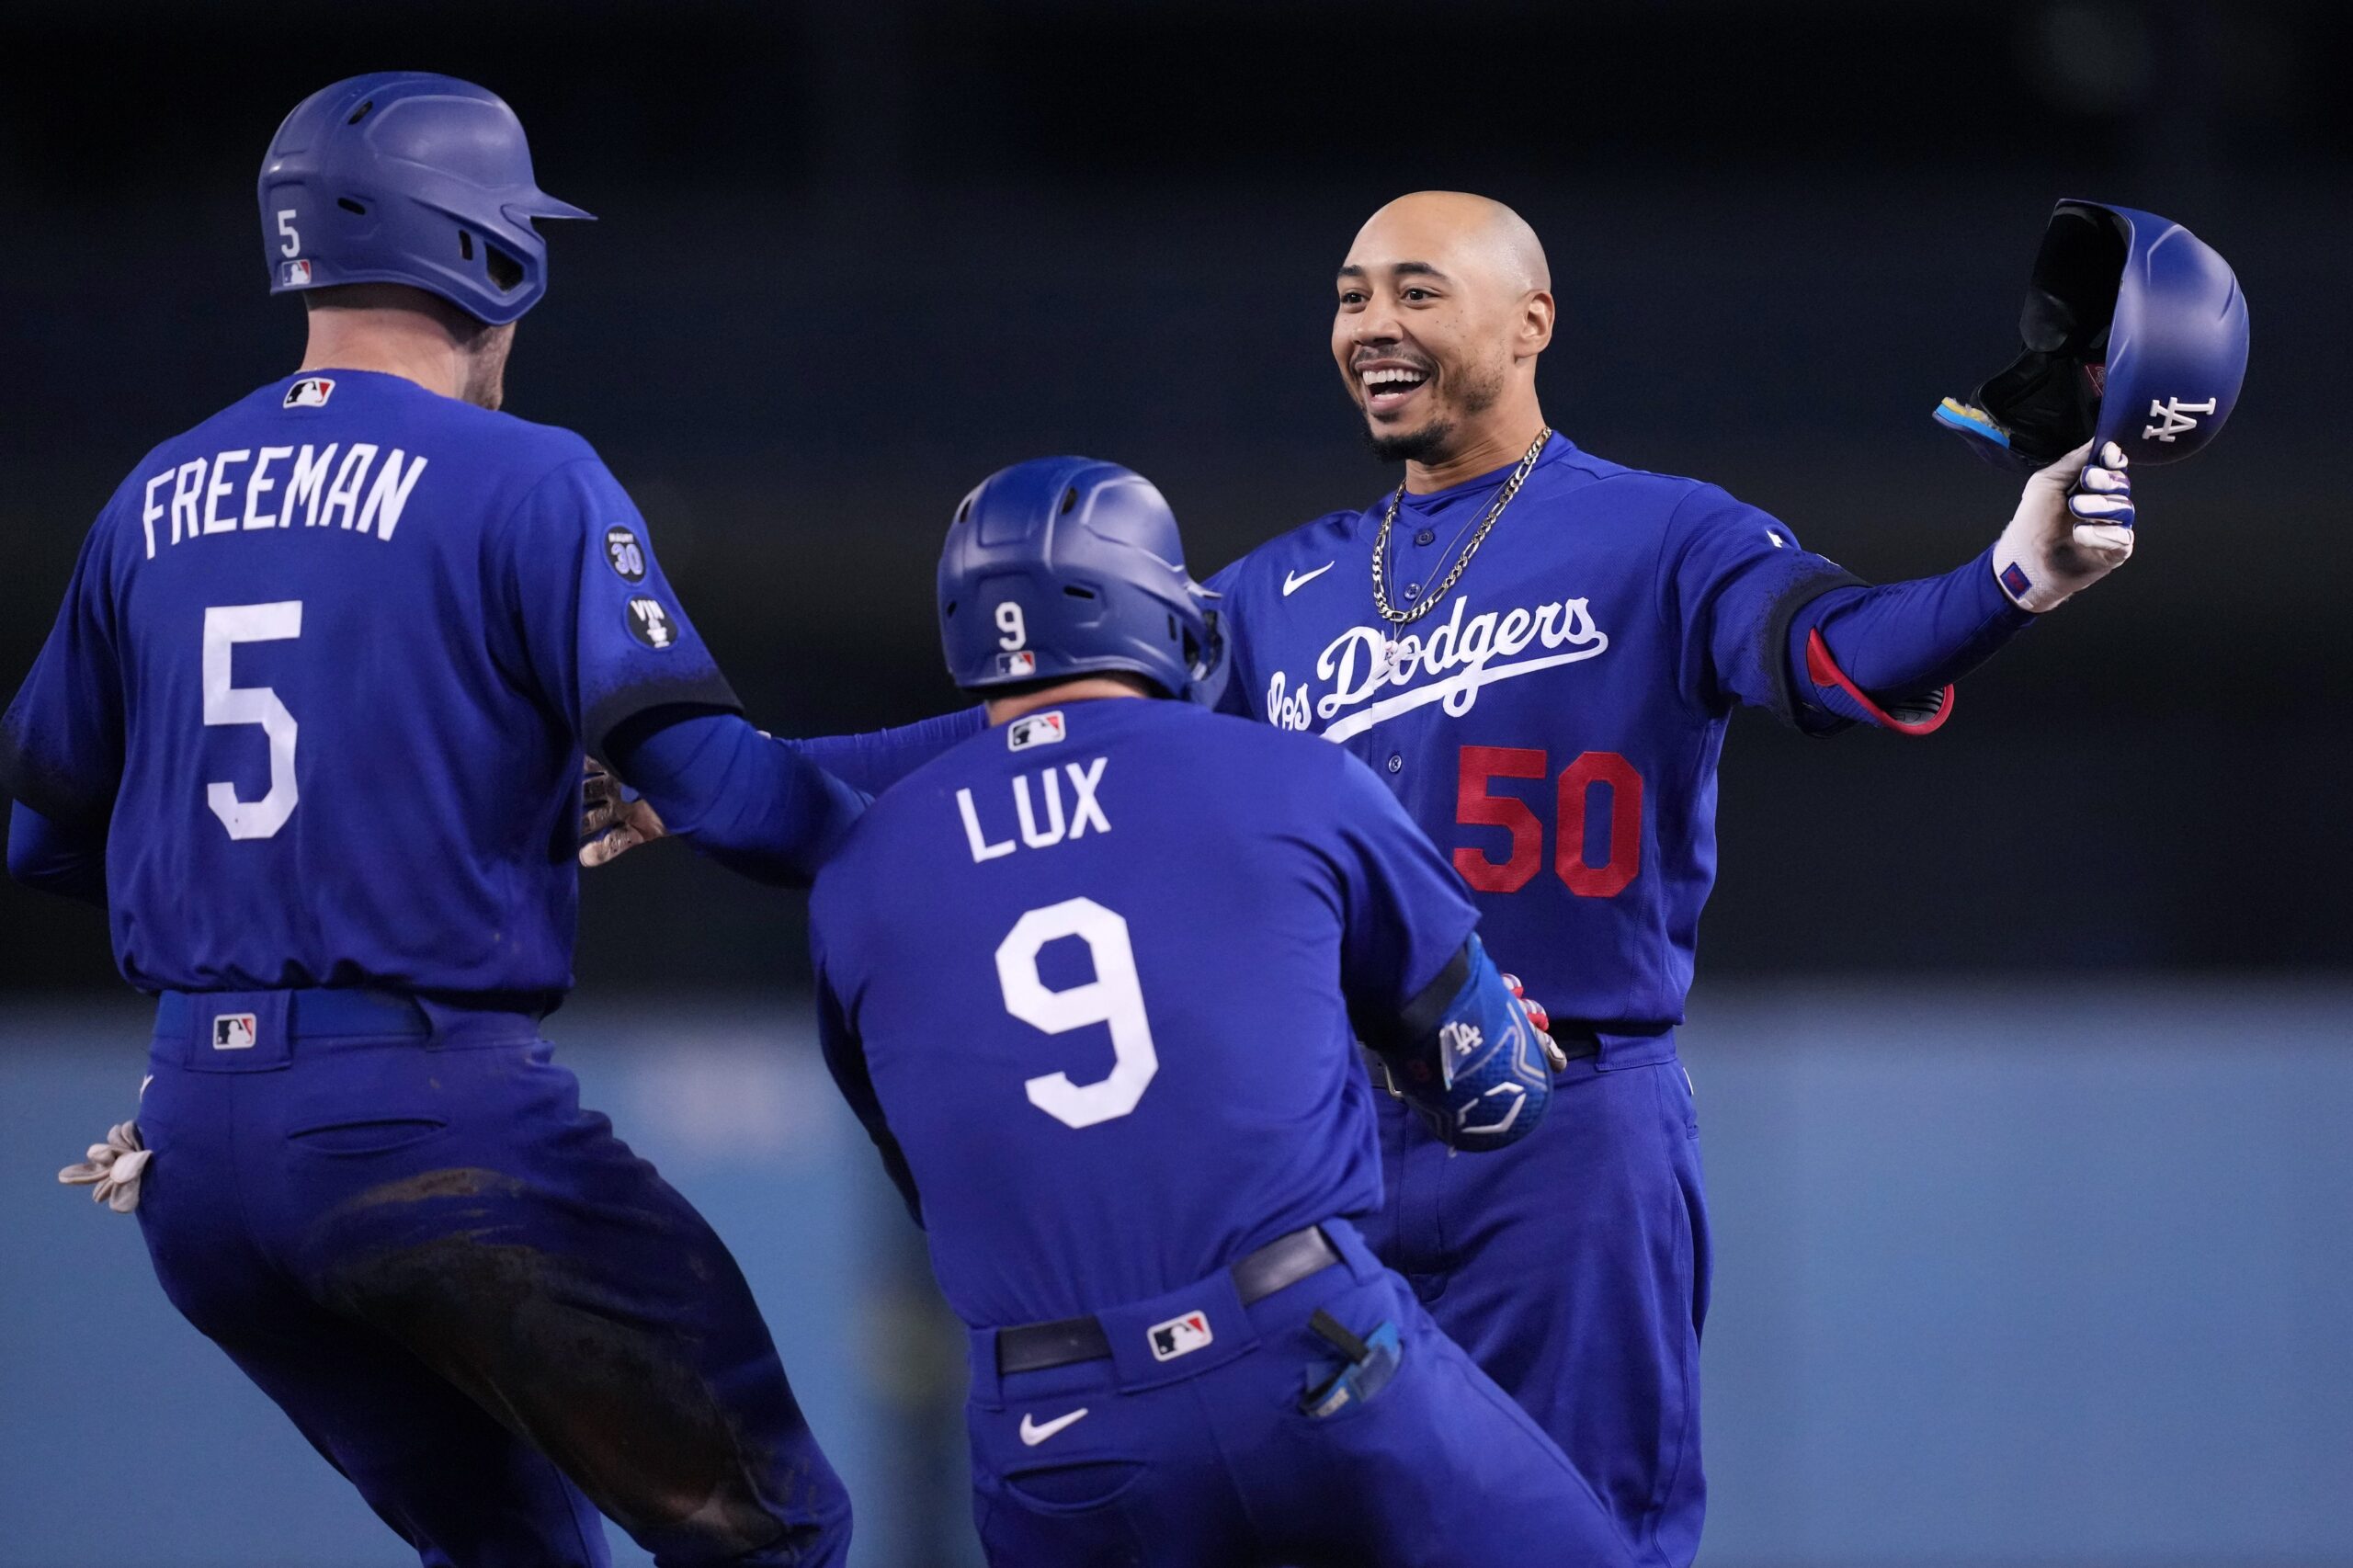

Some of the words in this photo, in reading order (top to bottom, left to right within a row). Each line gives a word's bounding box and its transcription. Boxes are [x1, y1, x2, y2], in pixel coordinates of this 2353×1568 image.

[278, 209, 301, 258] 5
[2143, 396, 2217, 443] LA
[142, 442, 428, 560] FREEMAN
[610, 542, 643, 575] 30
[995, 601, 1027, 651] 9
[1316, 595, 1608, 718] Dodgers
[202, 600, 303, 840] 5
[955, 756, 1112, 864] LUX
[1452, 744, 1643, 898] 50
[994, 896, 1159, 1130] 9
[1445, 1021, 1483, 1056] LA
